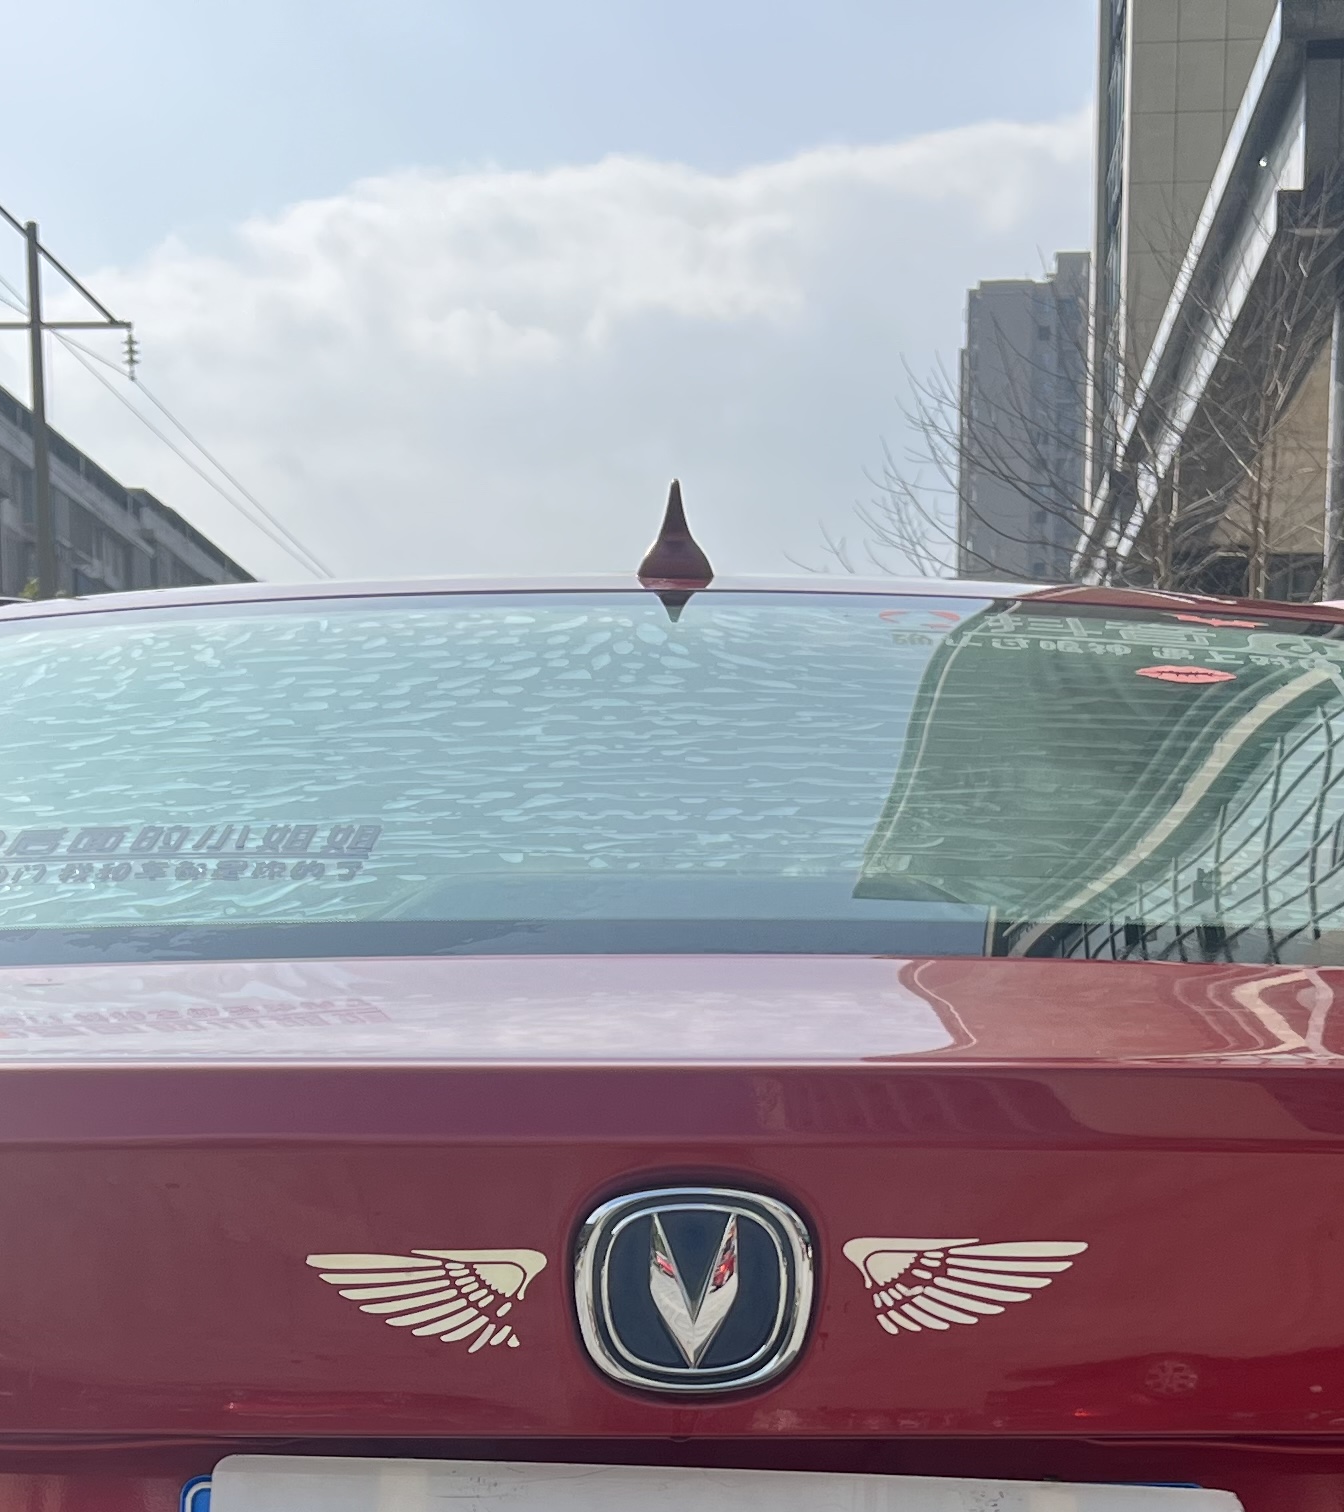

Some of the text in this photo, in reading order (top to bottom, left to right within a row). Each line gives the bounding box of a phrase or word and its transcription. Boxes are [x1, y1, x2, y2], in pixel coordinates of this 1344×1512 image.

[5, 823, 383, 856] 后面的小姐姐
